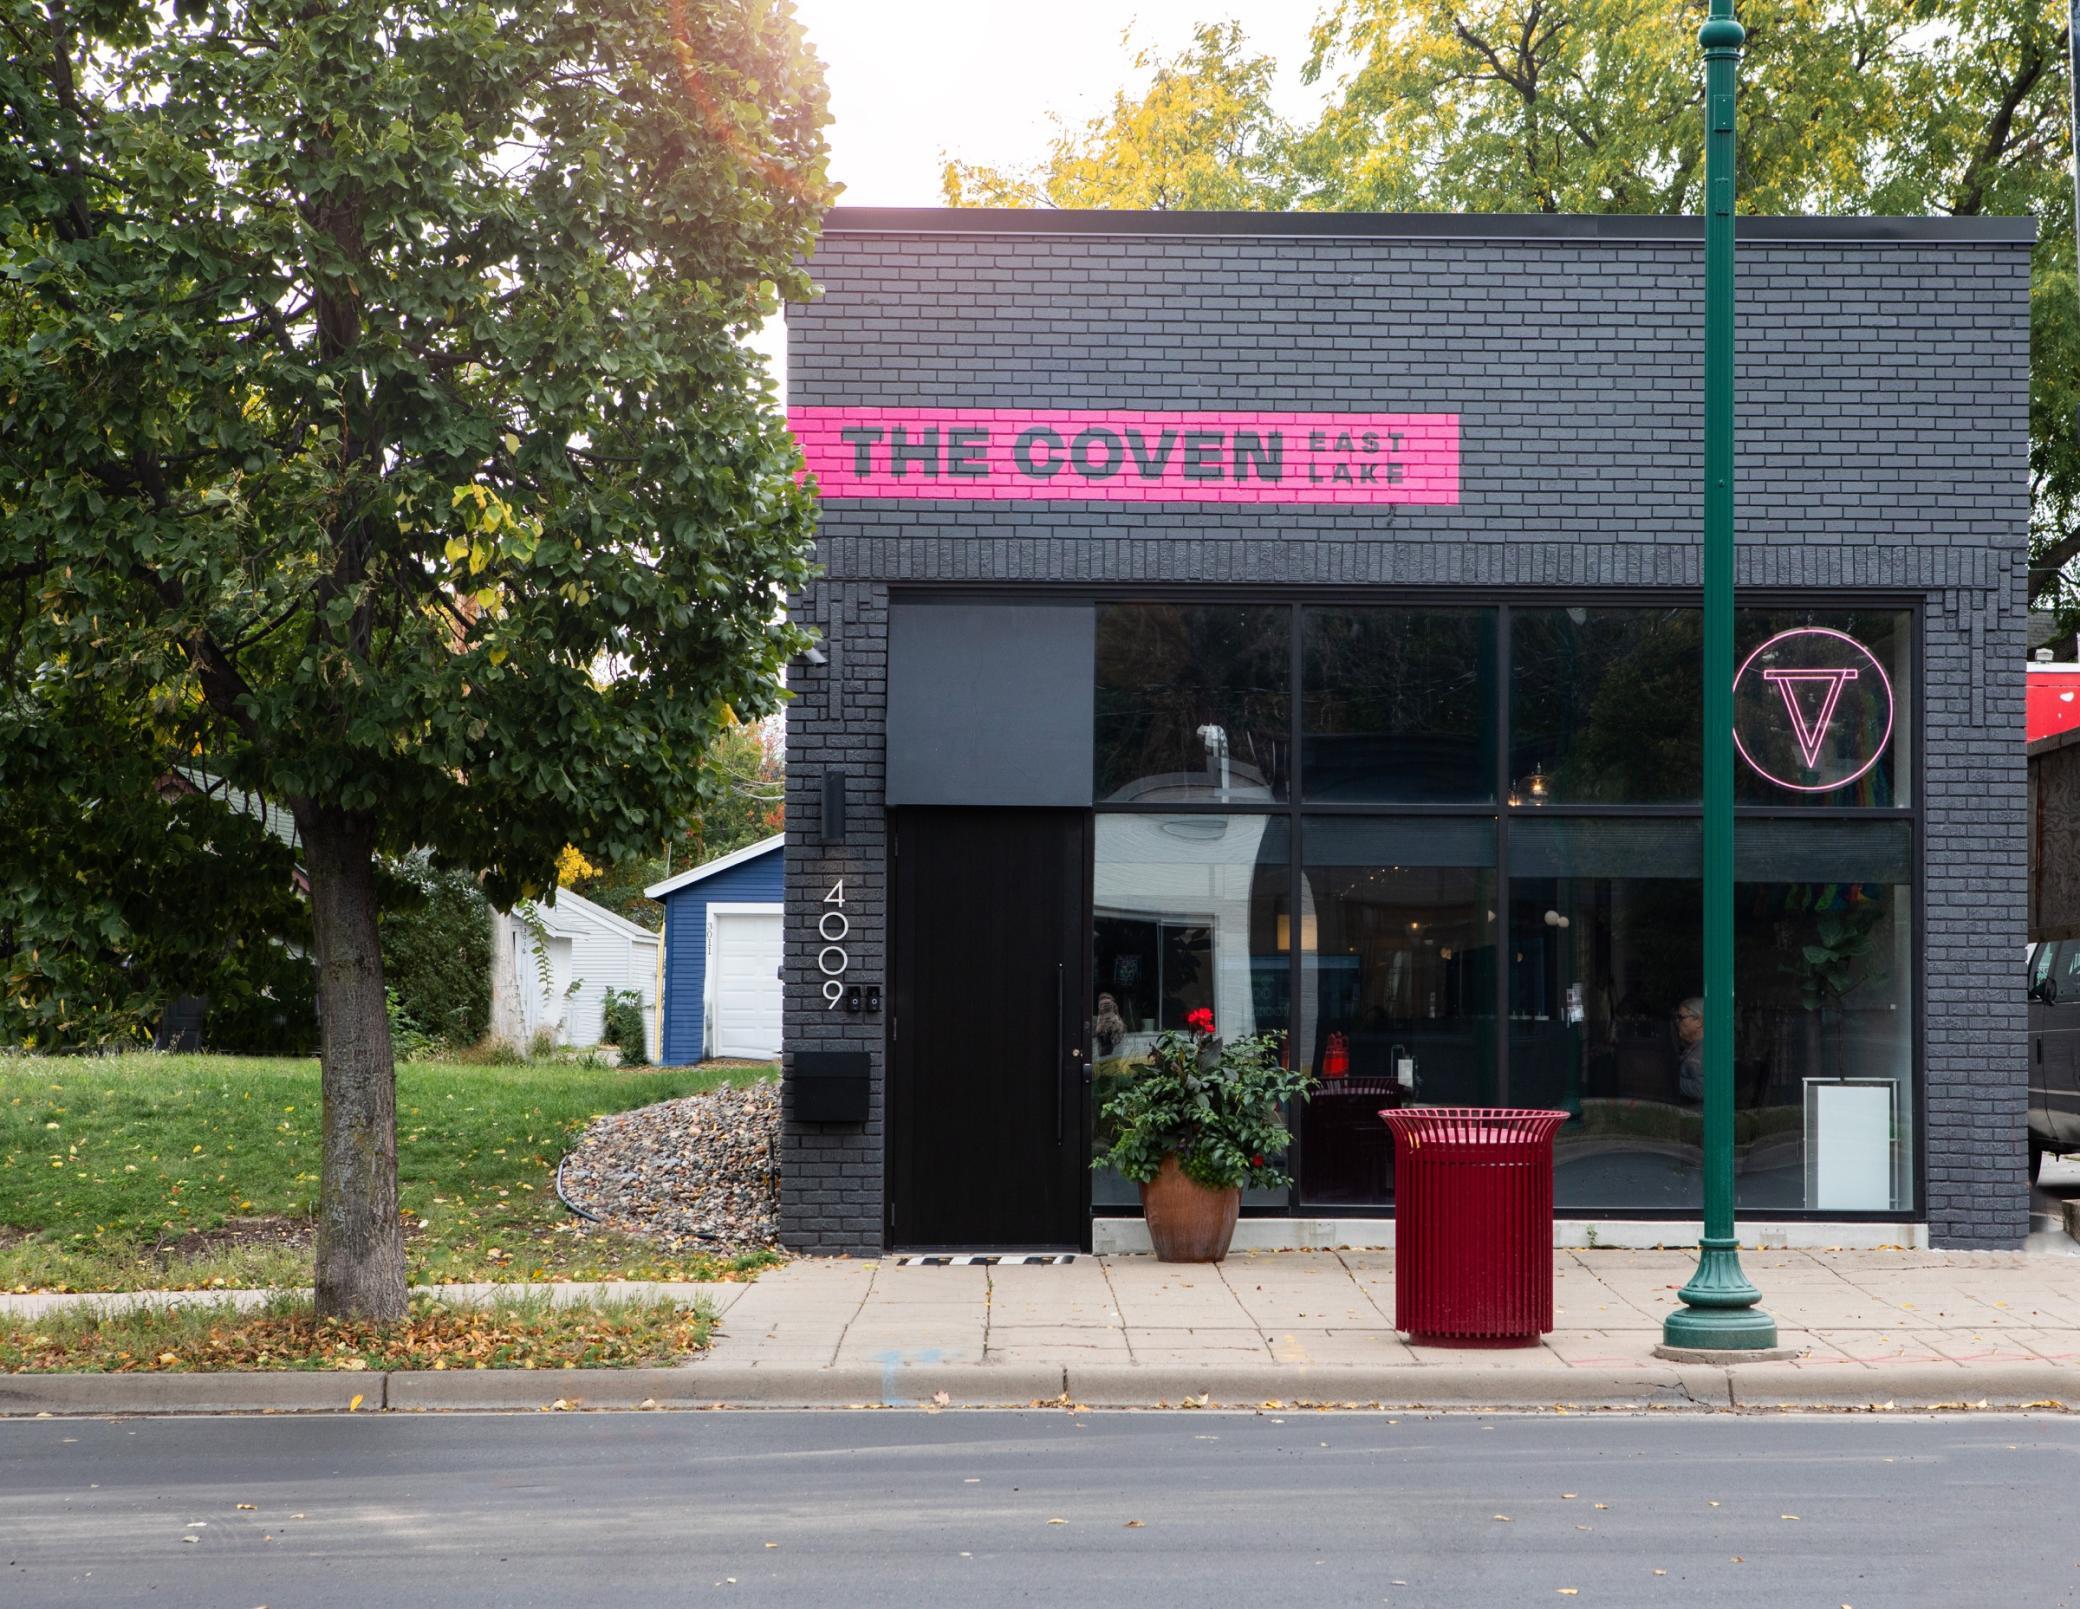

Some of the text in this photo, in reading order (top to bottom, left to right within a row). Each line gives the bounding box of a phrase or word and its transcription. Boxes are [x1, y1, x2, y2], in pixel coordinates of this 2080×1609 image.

[841, 426, 1283, 482] THE COVEN
[1308, 431, 1404, 454] EAST
[1308, 462, 1404, 484] LAKE
[818, 878, 849, 1010] 4009
